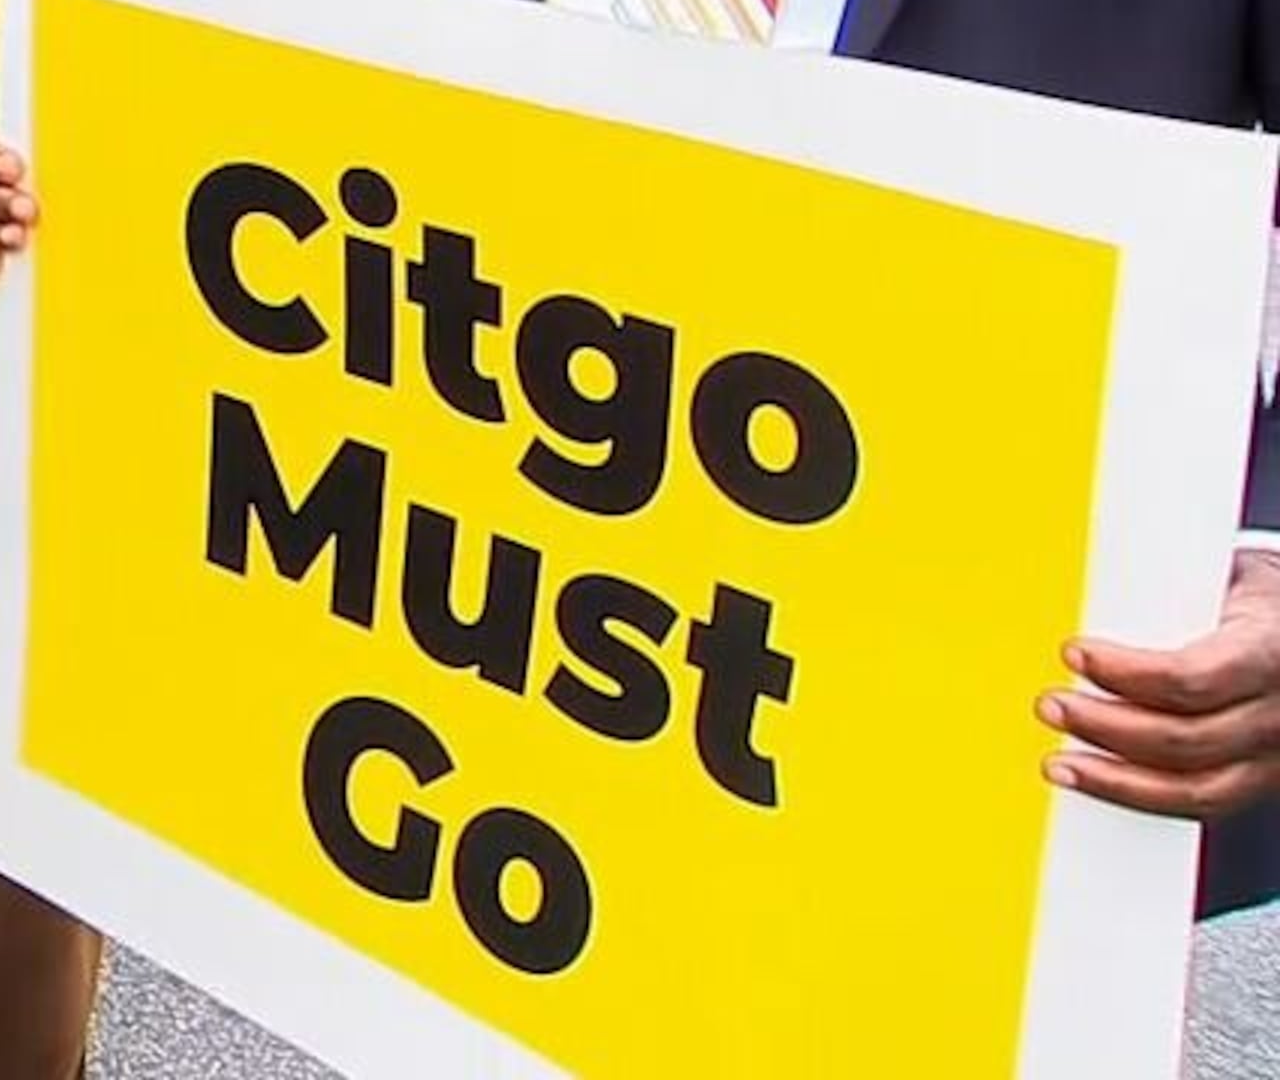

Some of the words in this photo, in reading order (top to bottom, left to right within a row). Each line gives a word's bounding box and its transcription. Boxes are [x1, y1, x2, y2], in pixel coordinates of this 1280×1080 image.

[184, 161, 862, 526] Citgo
[205, 390, 796, 810] Must
[301, 695, 595, 976] Go
